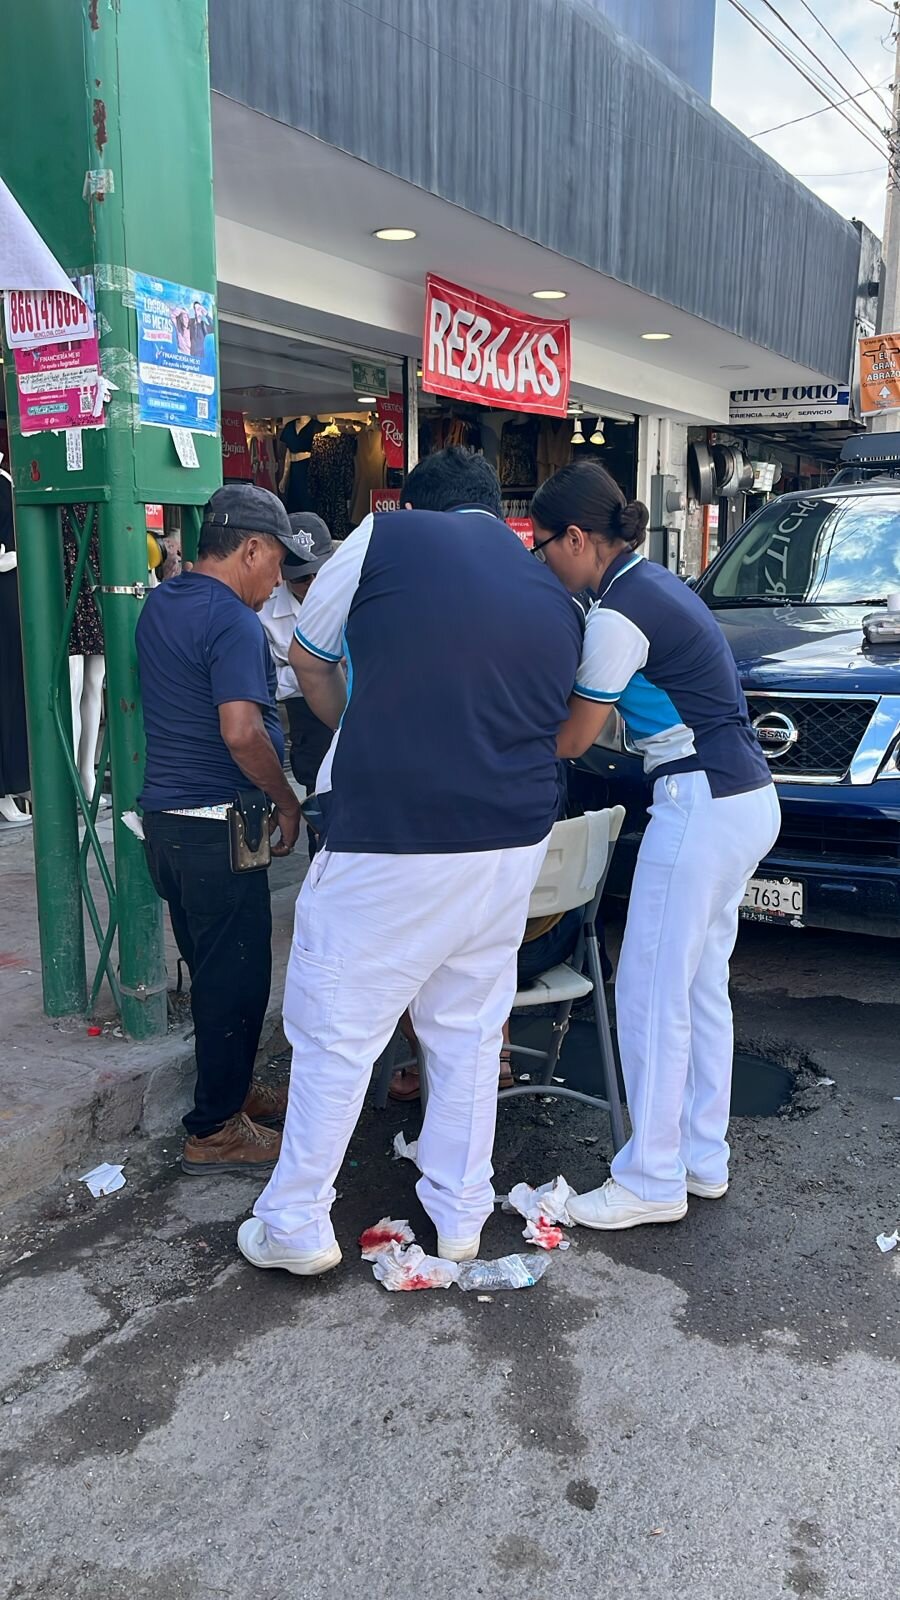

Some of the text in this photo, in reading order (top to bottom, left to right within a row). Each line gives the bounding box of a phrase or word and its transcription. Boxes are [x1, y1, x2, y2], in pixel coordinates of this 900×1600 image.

[428, 298, 561, 397] REBAJAS
[879, 352, 890, 360] EL
[872, 361, 896, 371] GRAN
